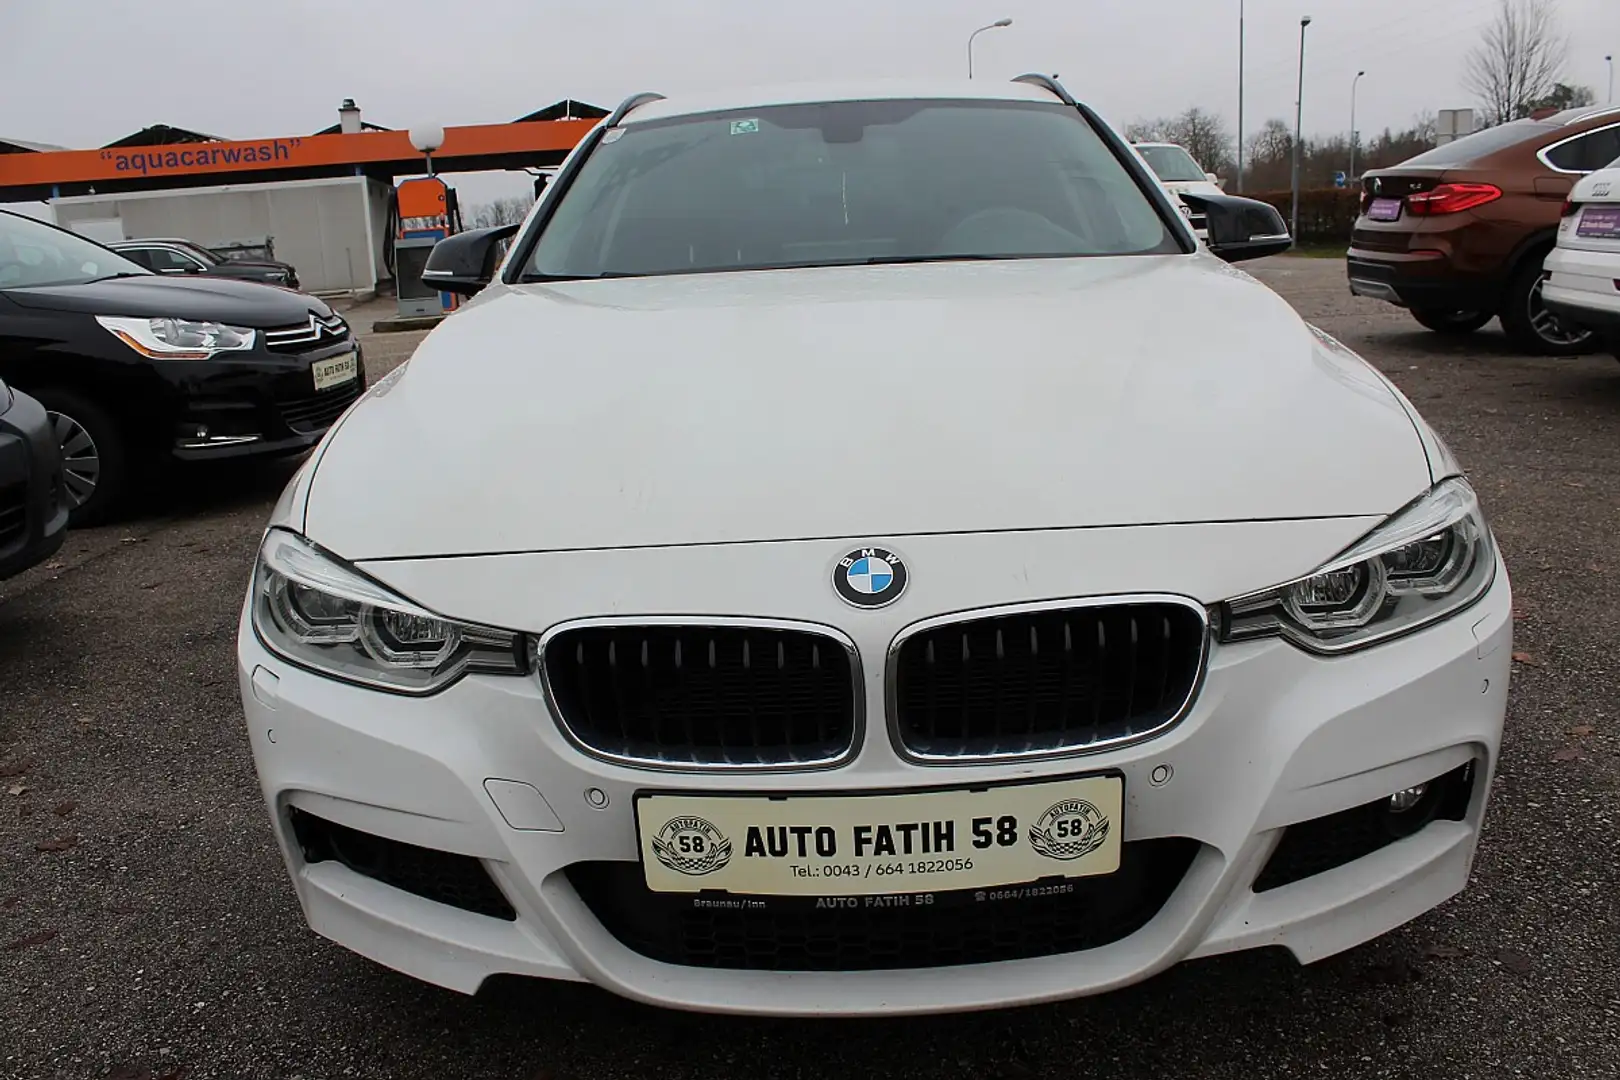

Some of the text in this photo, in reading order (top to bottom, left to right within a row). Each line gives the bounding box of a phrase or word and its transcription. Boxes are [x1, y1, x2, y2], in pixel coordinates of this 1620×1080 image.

[840, 548, 900, 568] BMW
[745, 815, 1018, 857] AUTO FATIH 58
[1056, 818, 1082, 838] 58
[678, 835, 705, 853] 58
[790, 858, 973, 879] Tel.: 0043 / 664 1822056
[693, 898, 766, 909] Braunau/Inn
[816, 893, 934, 909] AUTO FATIH 58
